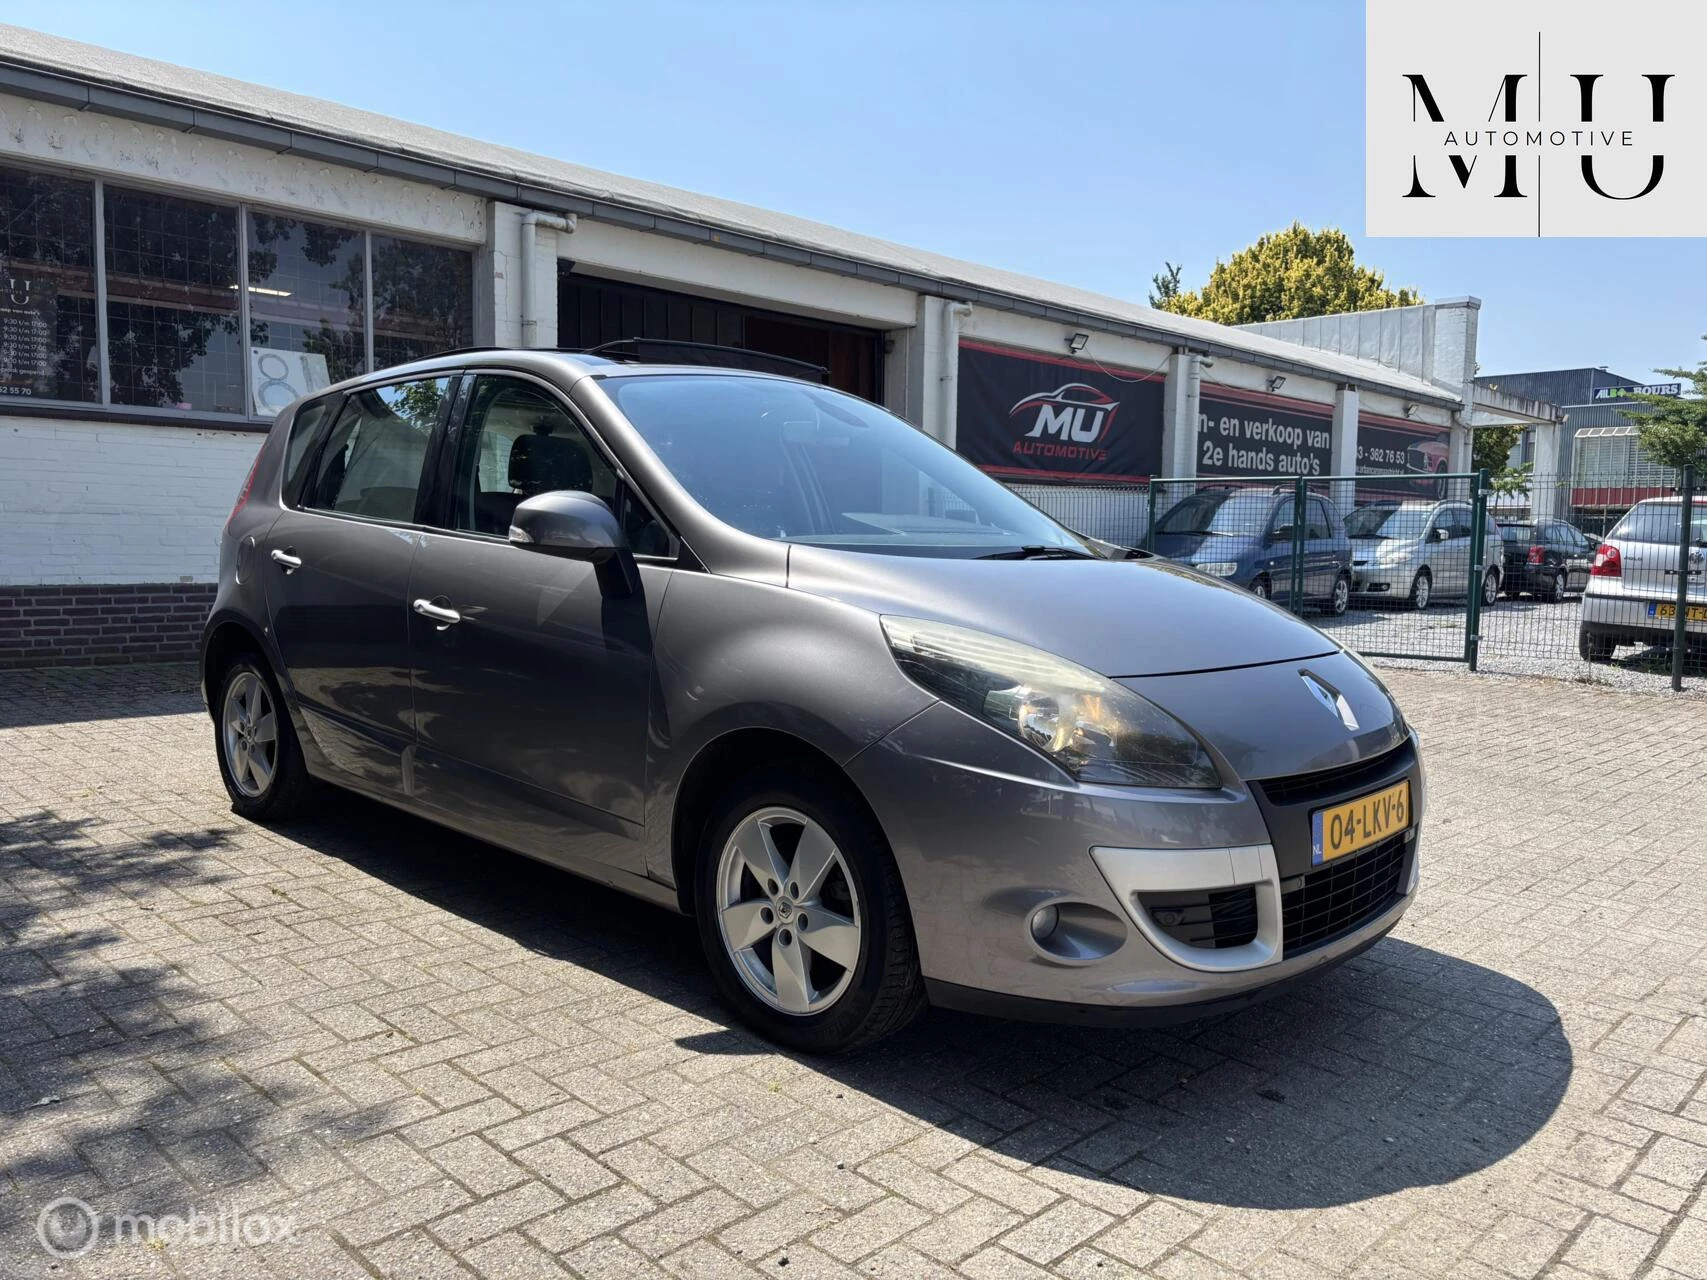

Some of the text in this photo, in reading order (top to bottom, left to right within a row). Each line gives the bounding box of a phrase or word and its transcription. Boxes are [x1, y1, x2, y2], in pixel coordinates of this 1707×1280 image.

[10, 386, 20, 394] 55
[21, 387, 32, 396] 70
[1024, 403, 1105, 443] MU
[1220, 416, 1240, 437] en
[1244, 418, 1302, 450] verkoop
[1306, 429, 1330, 449] van
[1012, 440, 1107, 461] AUTOMOTIVE
[1202, 440, 1320, 476] 2e hands auto's
[1370, 448, 1384, 462] 362
[1385, 450, 1395, 464] 76
[1396, 451, 1405, 465] 53
[1330, 789, 1405, 850] 04-LKV-6
[1312, 844, 1322, 855] NL
